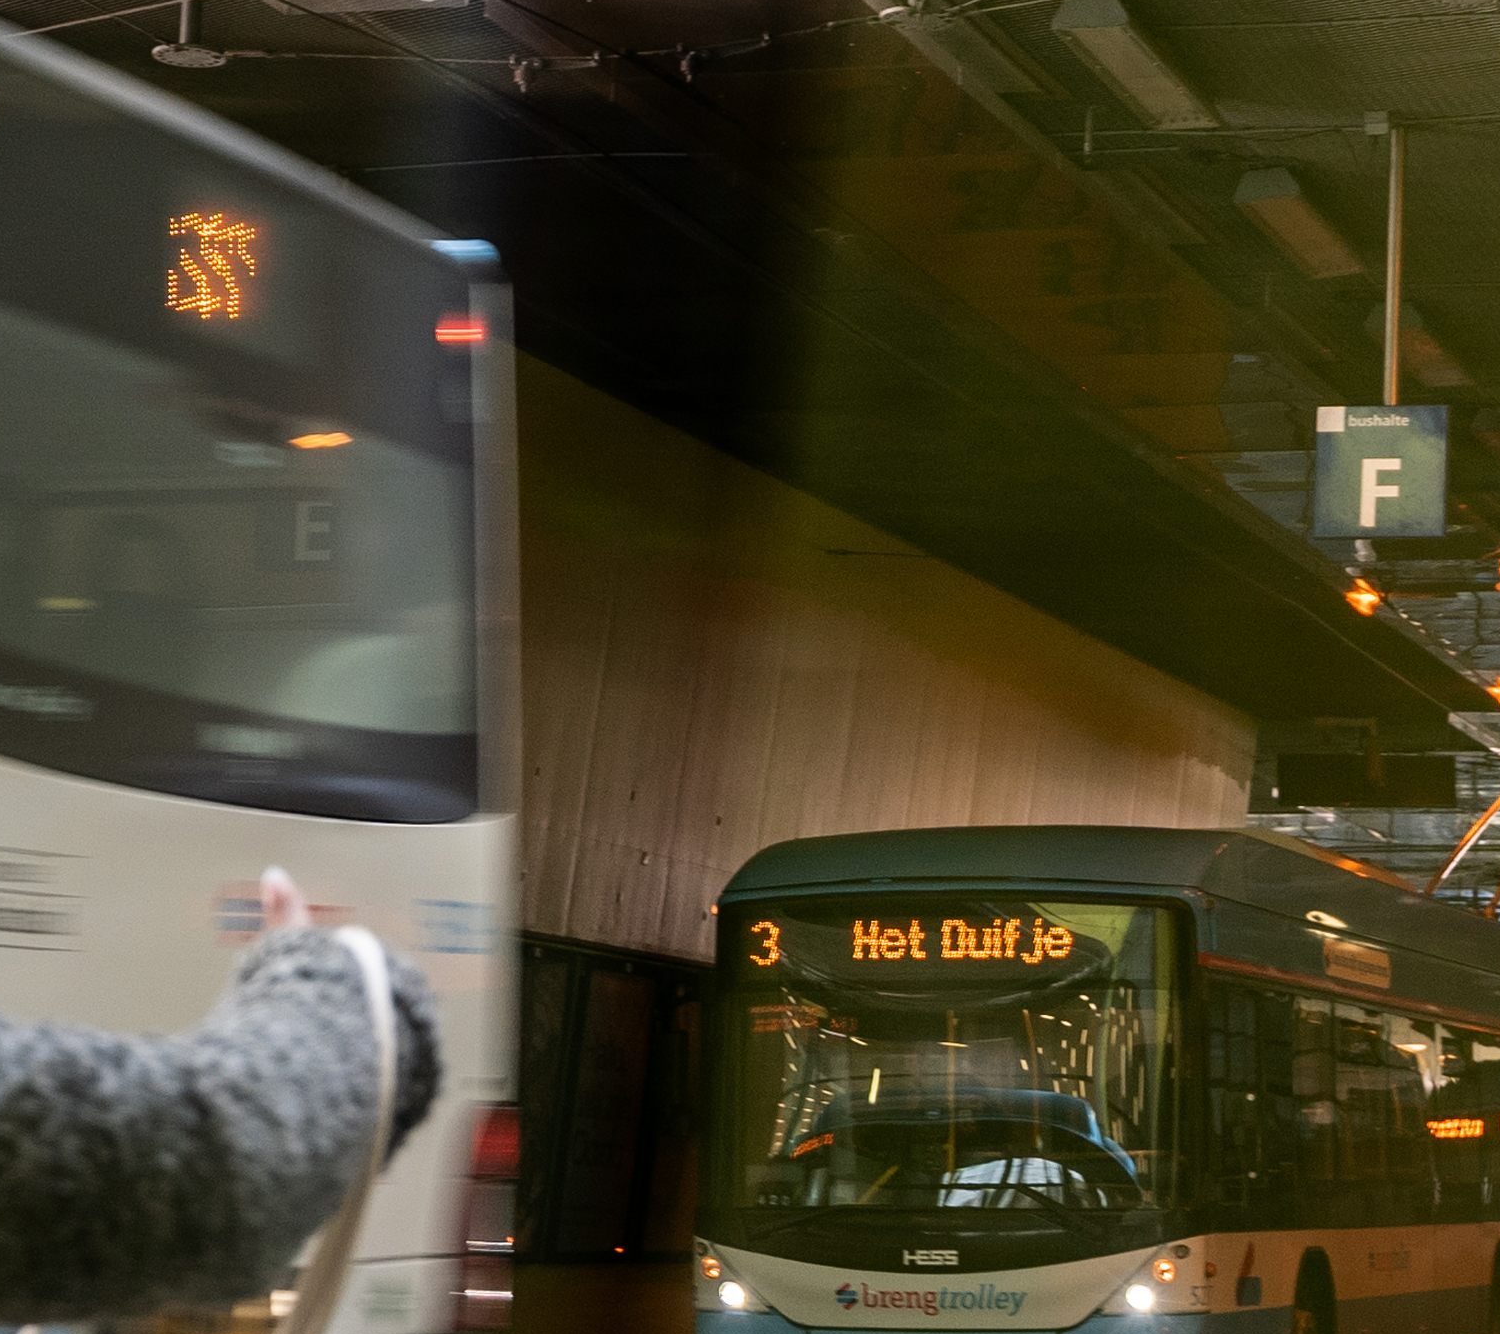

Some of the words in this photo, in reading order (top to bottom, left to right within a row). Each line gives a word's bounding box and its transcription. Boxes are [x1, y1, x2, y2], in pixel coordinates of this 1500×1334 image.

[1347, 414, 1410, 427] bushalte
[1359, 458, 1402, 527] F
[750, 921, 781, 967] 3
[853, 917, 926, 961] Het
[903, 1249, 959, 1265] HESS
[862, 1282, 1027, 1317] brengtrolley
